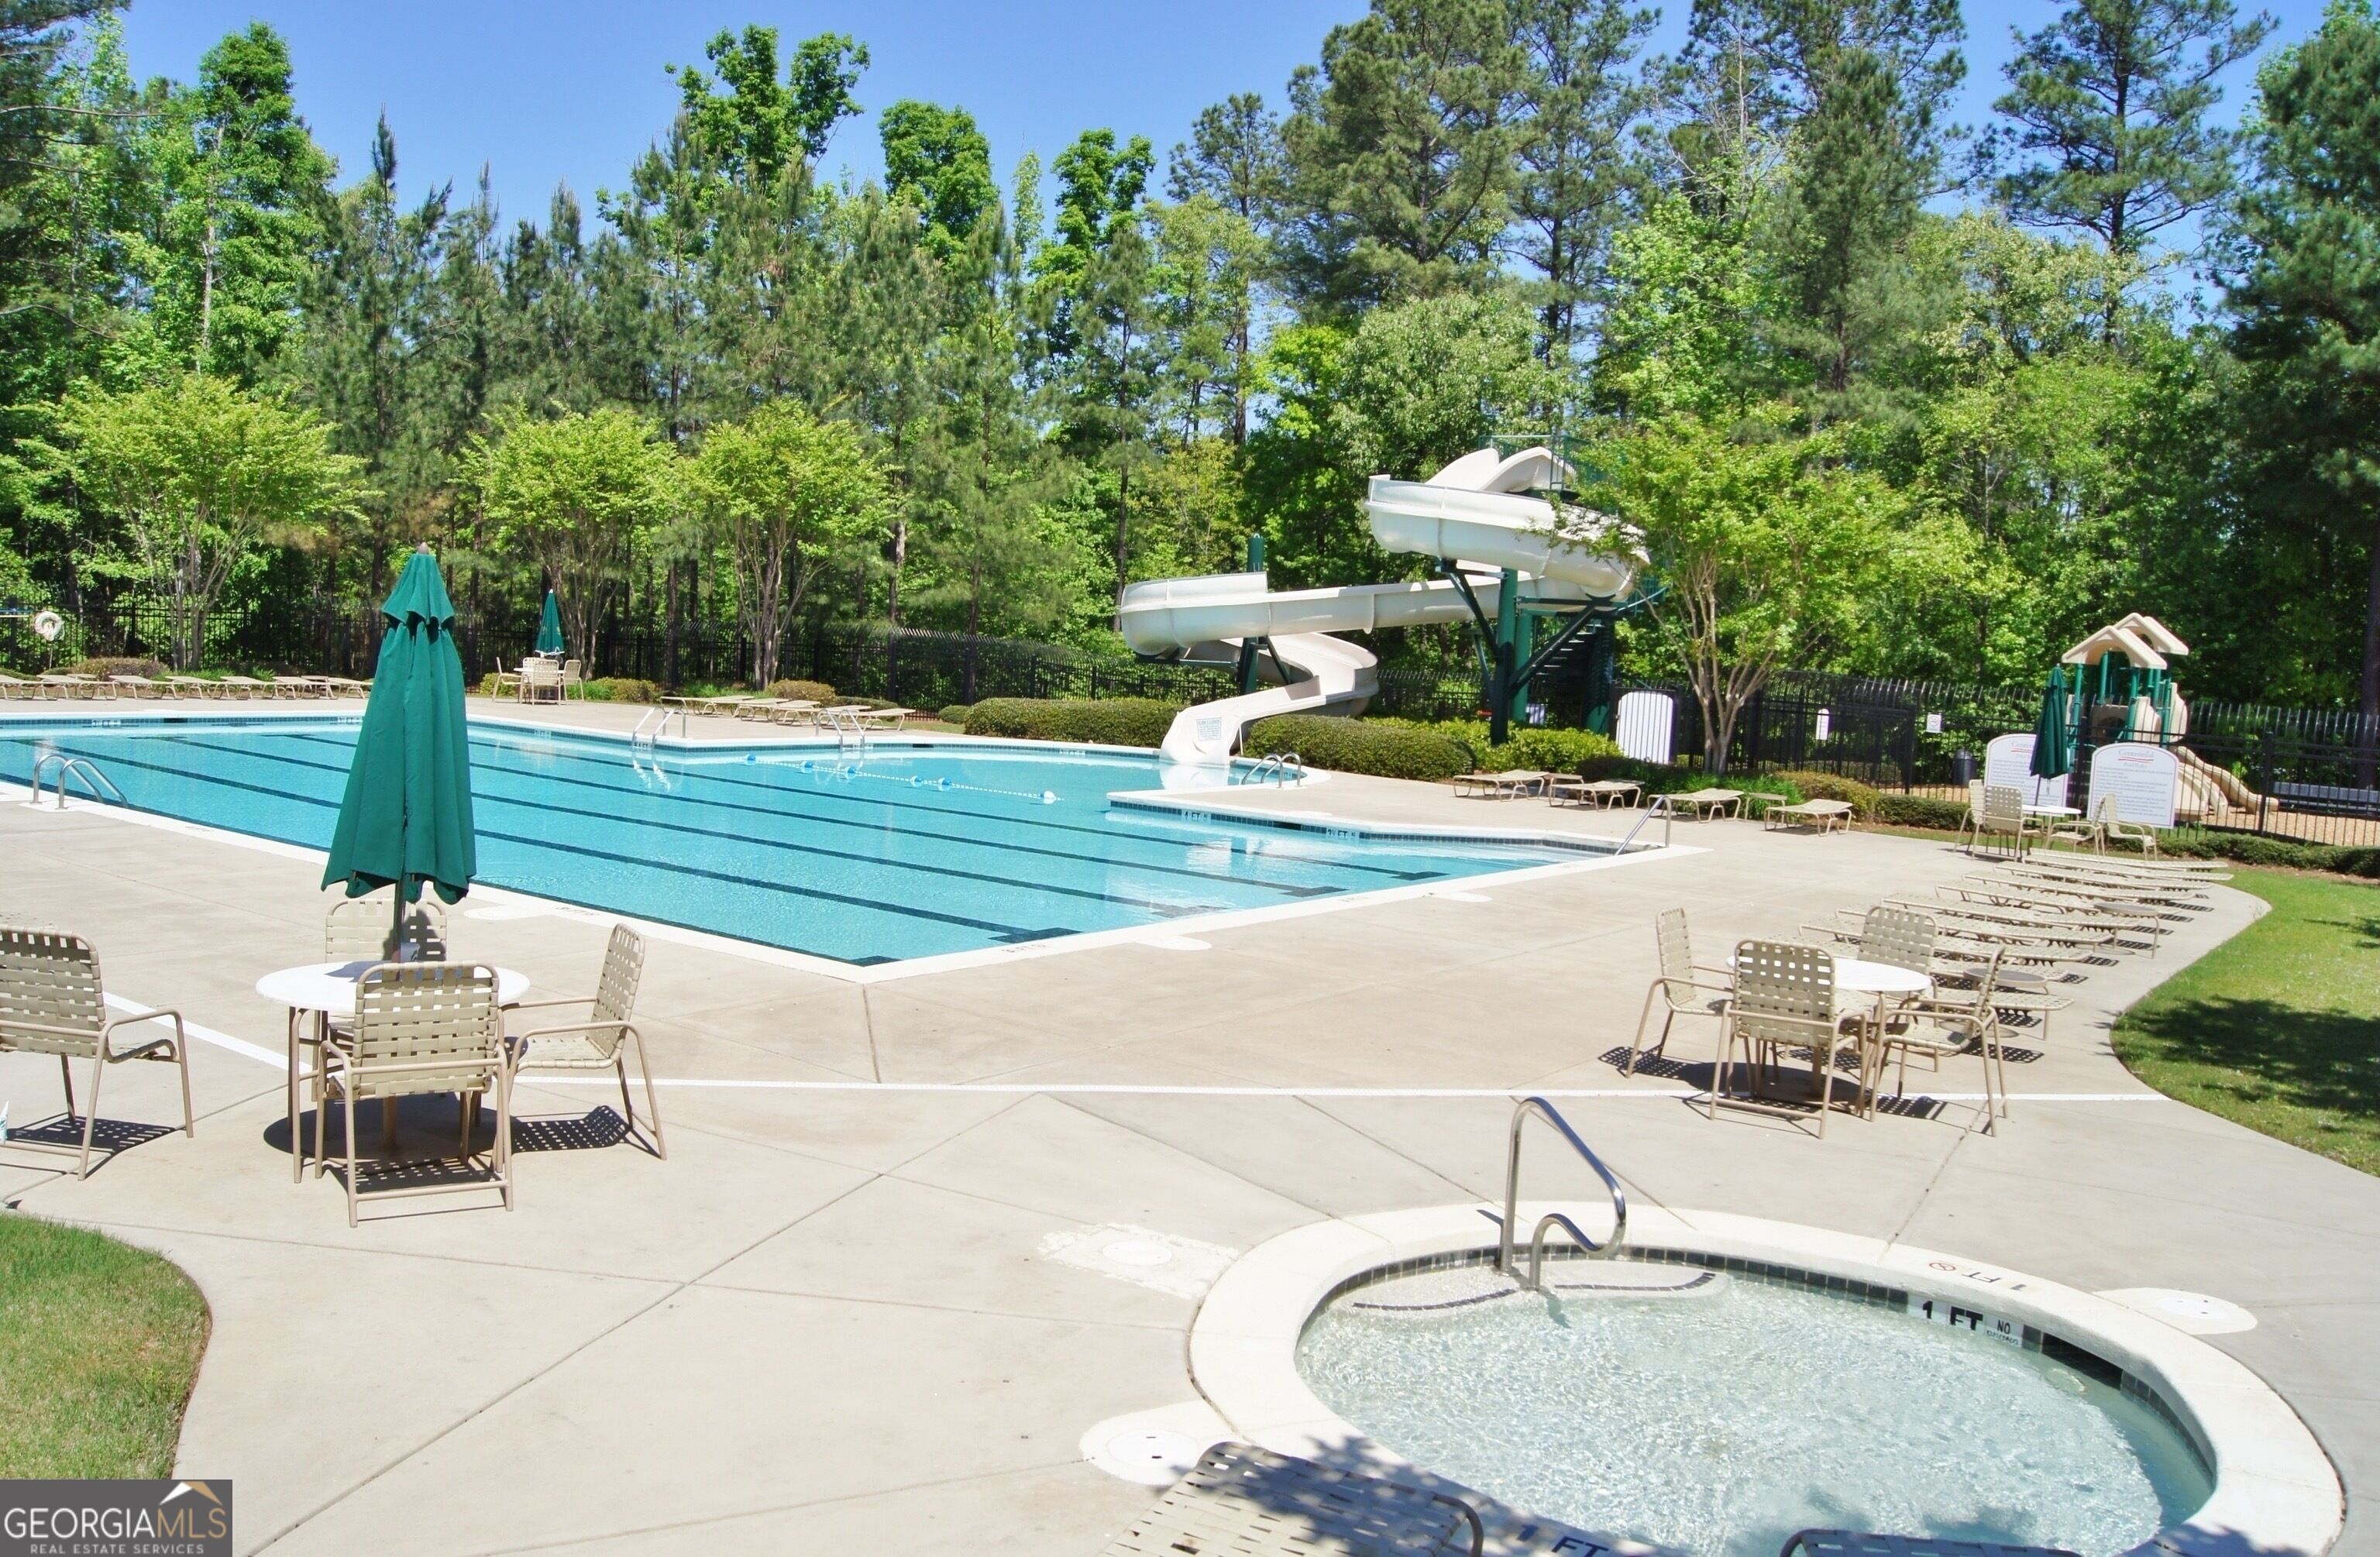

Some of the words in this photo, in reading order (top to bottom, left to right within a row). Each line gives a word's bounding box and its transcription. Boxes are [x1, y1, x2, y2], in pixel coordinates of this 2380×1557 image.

[1922, 1301, 1933, 1319] 1
[1950, 1306, 1983, 1331] FT
[1997, 1319, 2011, 1335] NO
[1516, 1524, 1539, 1542] 1
[1551, 1536, 1609, 1557] FT
